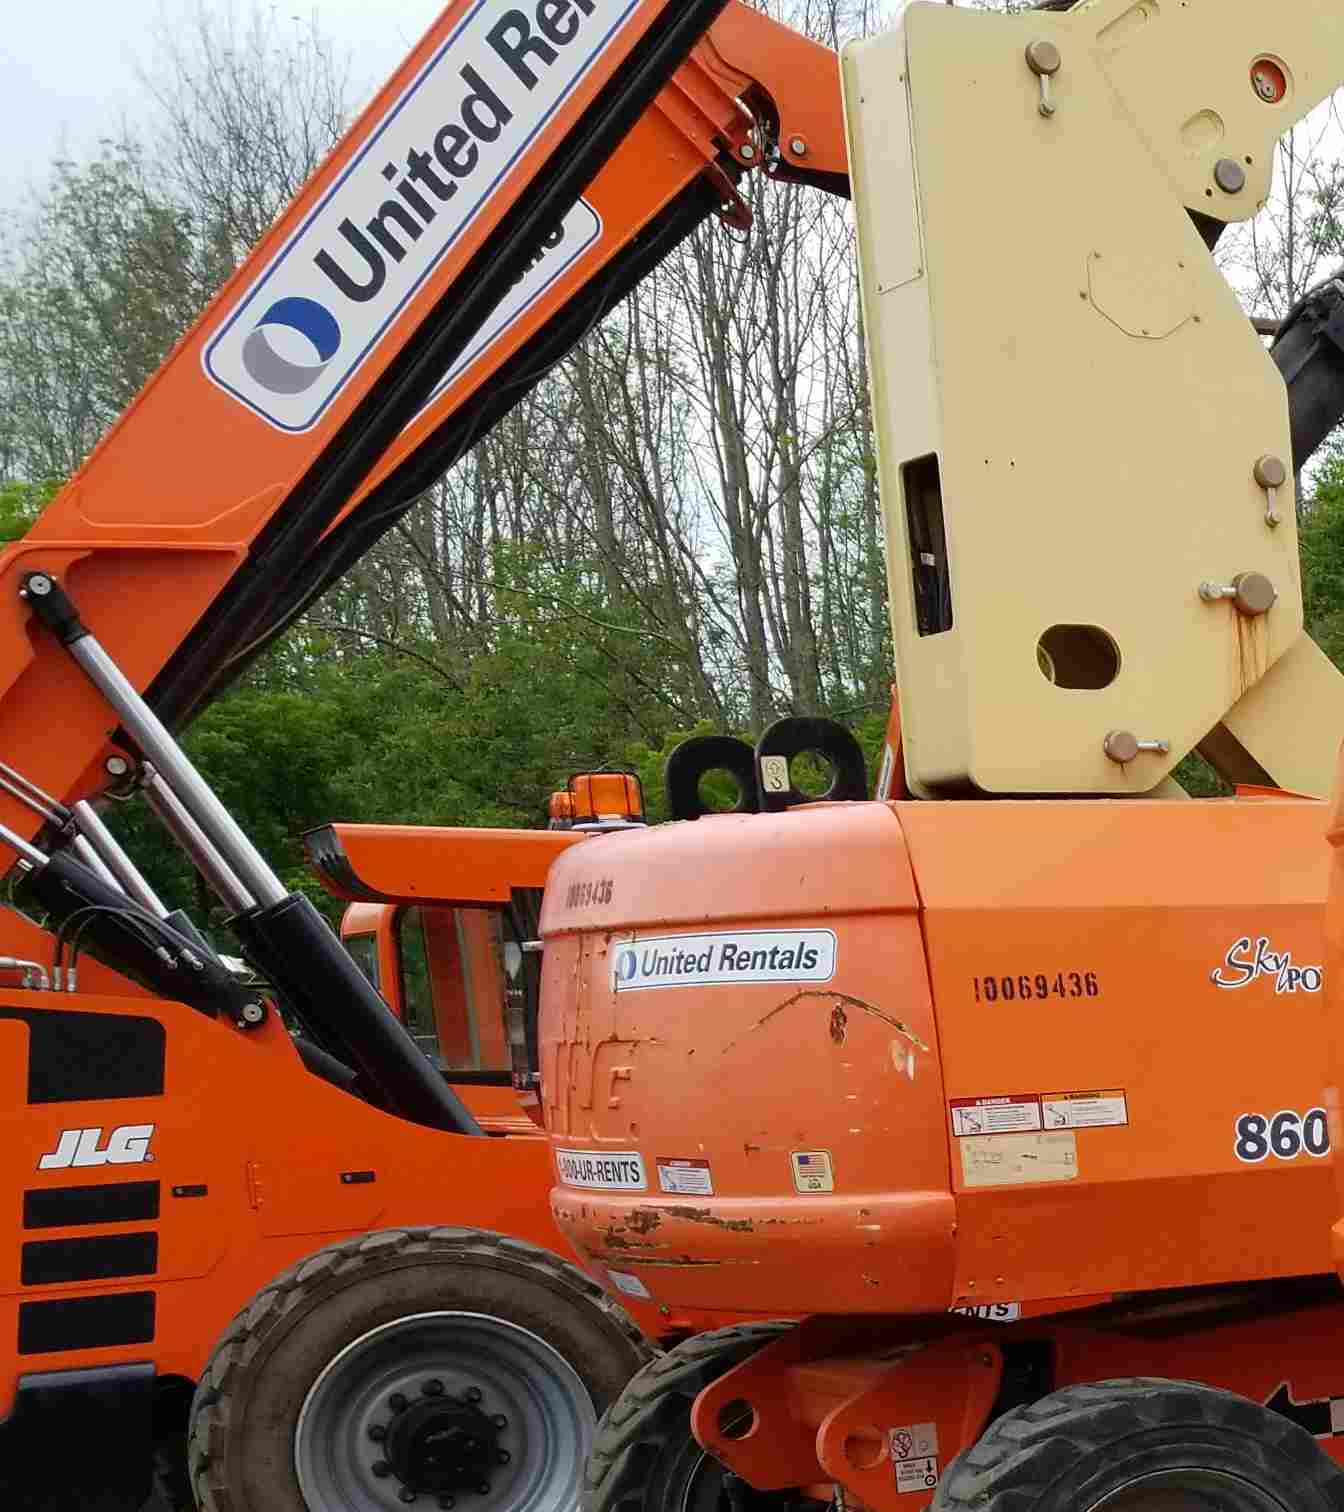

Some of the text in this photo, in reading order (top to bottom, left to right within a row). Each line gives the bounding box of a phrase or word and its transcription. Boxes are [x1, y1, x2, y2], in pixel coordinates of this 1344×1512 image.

[313, 0, 597, 303] United Re
[640, 941, 819, 977] United Rentals
[973, 971, 1100, 1003] 10069436
[36, 1123, 155, 1170] JLG
[1236, 1108, 1331, 1161] 860
